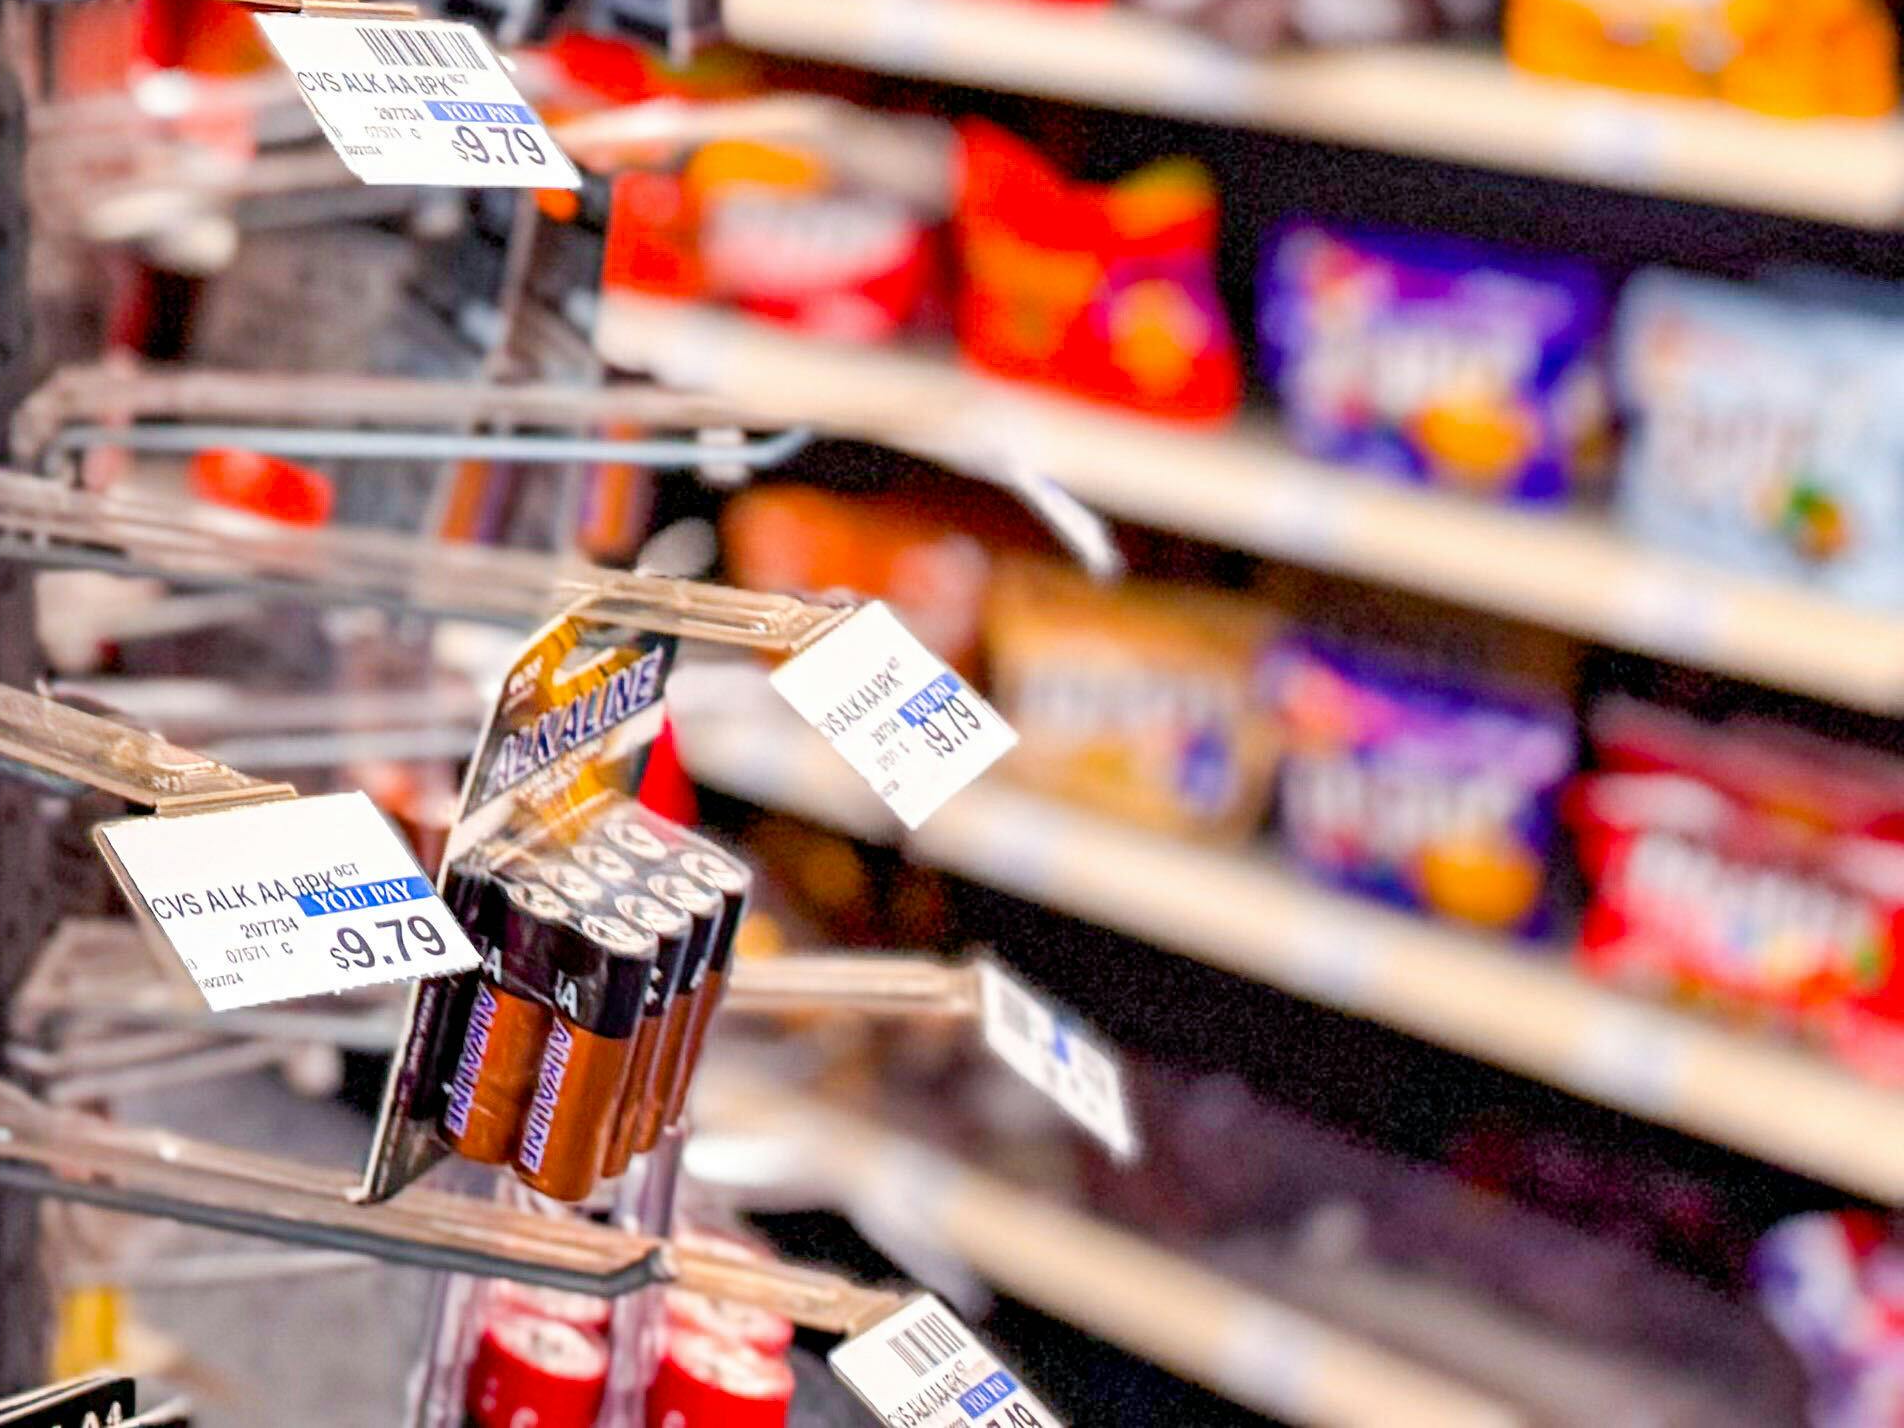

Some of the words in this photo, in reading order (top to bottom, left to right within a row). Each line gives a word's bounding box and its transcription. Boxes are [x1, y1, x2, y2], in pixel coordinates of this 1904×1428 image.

[297, 71, 341, 94] CVS
[343, 71, 383, 94] ALK
[386, 73, 412, 94] AA
[415, 75, 455, 97] 8PK
[452, 124, 547, 165] $9.79
[485, 645, 666, 794] ALKALINE
[153, 891, 204, 923] CVS
[206, 885, 254, 915] ALK
[260, 879, 295, 905] AA
[330, 914, 447, 972] $9.79
[445, 986, 500, 1138] ALKALINE
[519, 1021, 574, 1173] ALKALINE
